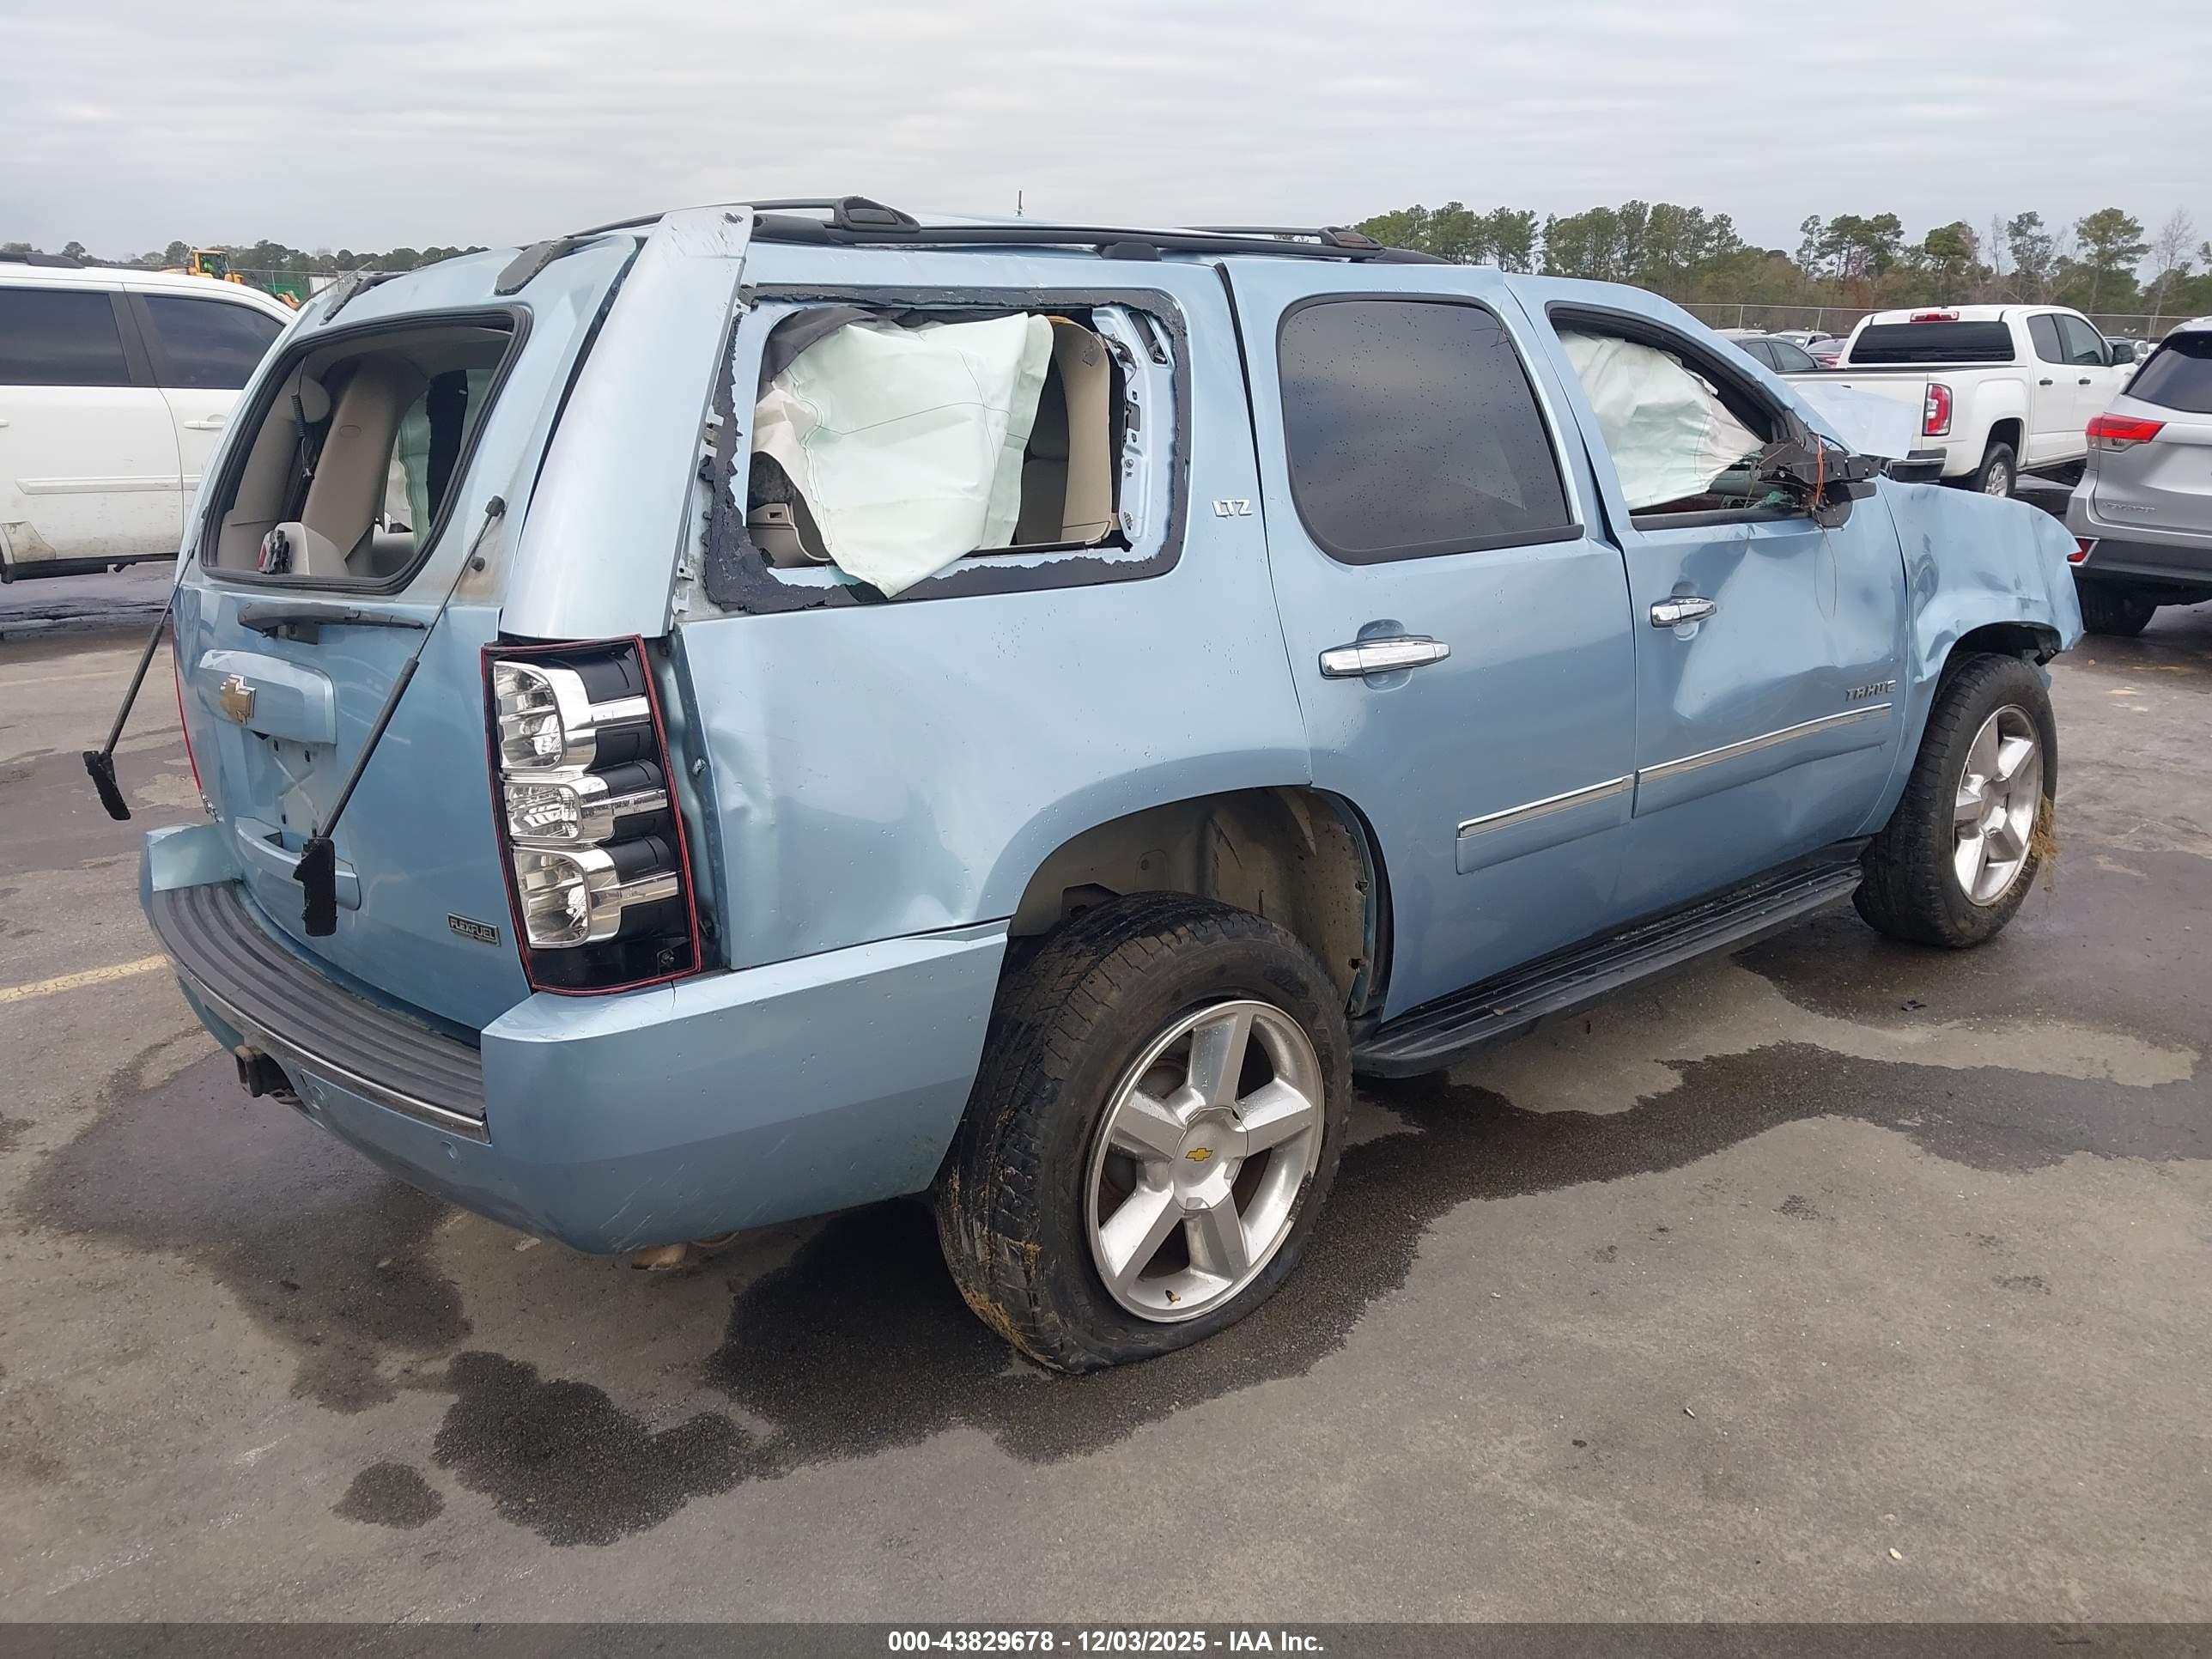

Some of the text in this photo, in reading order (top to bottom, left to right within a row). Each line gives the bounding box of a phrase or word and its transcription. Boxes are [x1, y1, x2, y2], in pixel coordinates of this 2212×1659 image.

[1212, 499, 1253, 517] LTZ
[1845, 679, 1897, 702] TAHOE
[450, 917, 495, 939] FLEXFUEL
